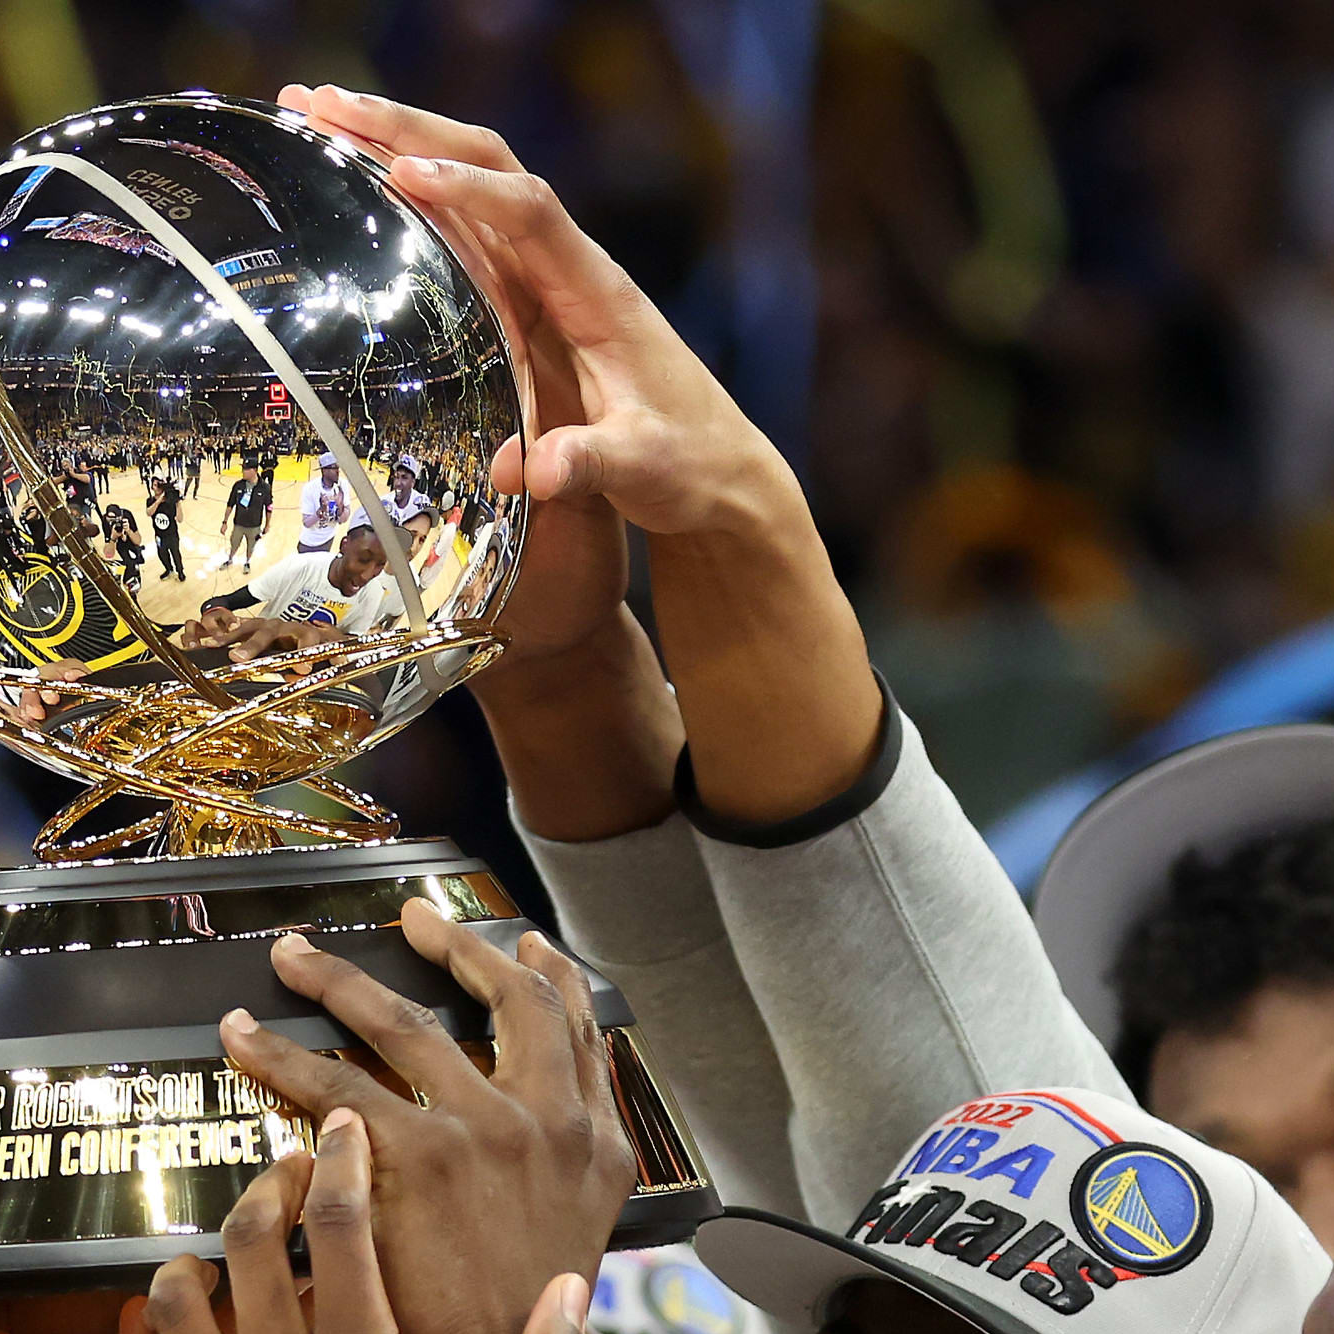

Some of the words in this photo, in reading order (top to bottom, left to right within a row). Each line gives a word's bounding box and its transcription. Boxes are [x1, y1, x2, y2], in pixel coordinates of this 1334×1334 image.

[11, 1070, 205, 1132] ROBERTSON
[943, 1102, 1034, 1129] 2022
[59, 1118, 263, 1177] CONFERENCE
[897, 1126, 1056, 1200] NBA
